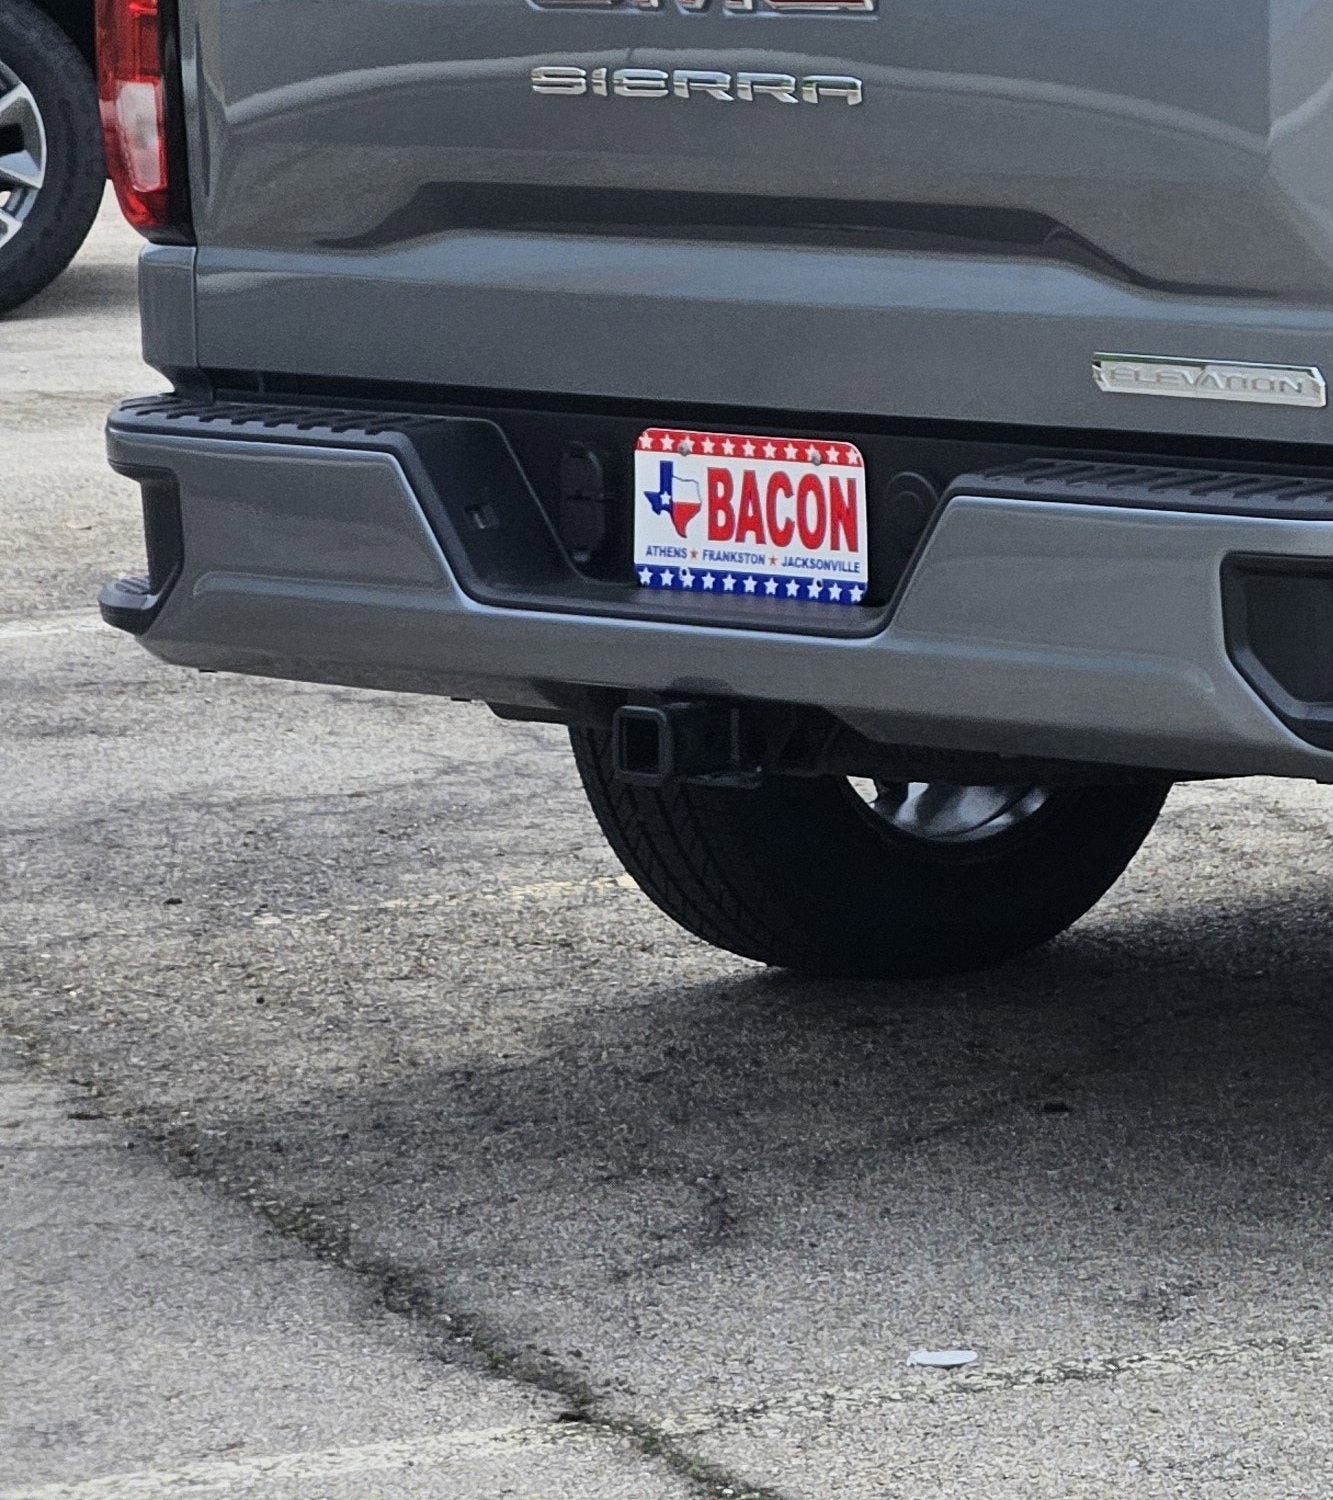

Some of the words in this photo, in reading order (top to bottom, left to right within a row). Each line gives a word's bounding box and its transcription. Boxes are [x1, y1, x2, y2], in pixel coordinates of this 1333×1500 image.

[530, 66, 864, 106] SIERRA
[1109, 364, 1303, 394] ELEVATION
[708, 467, 858, 552] BACON
[645, 544, 688, 559] ATHENS
[702, 549, 766, 566] FRANKSTON
[781, 554, 861, 574] JACKSONVILLE
